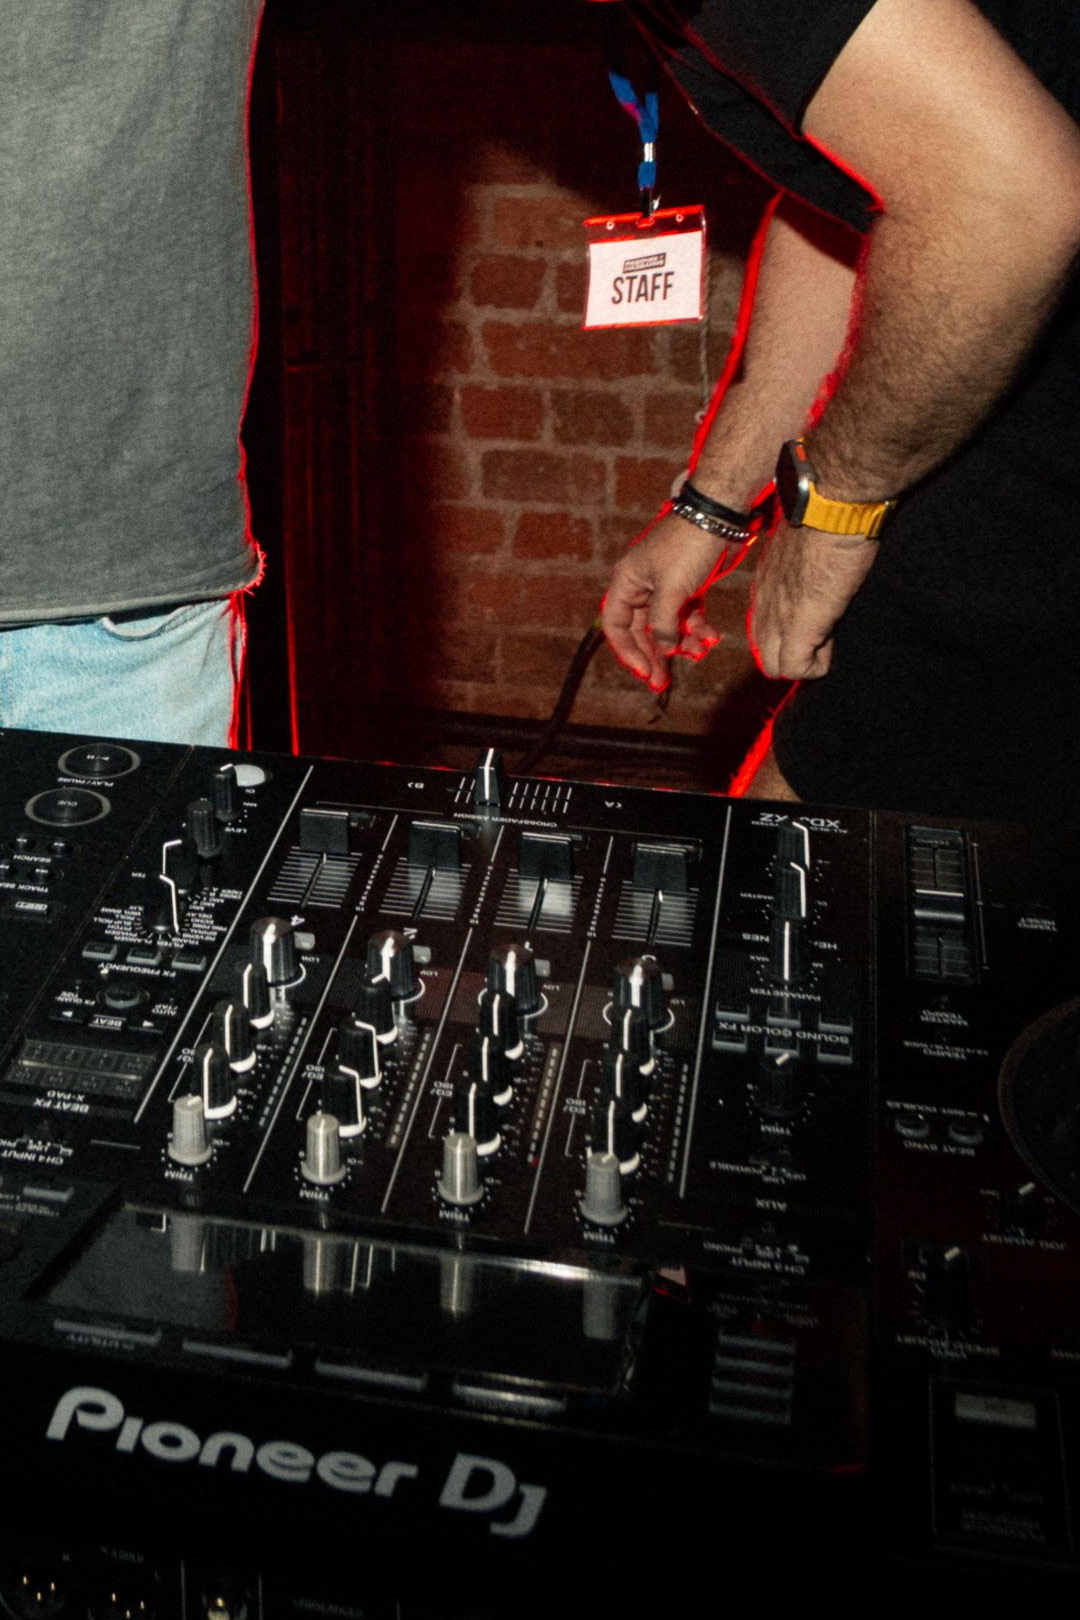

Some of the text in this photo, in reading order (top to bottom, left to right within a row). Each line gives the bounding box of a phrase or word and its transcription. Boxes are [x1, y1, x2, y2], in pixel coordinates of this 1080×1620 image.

[612, 272, 675, 304] STAFF
[57, 777, 114, 787] PLAY/PAUSE
[453, 812, 496, 822] ASSIGN
[13, 854, 52, 863] SEARCH
[18, 883, 49, 893] TRACK
[93, 916, 113, 924] ROLL
[185, 911, 212, 919] DELAY
[290, 915, 306, 925] 4
[104, 929, 138, 938] PHASER
[182, 933, 216, 941] REVERB
[189, 928, 218, 936] SPIRAL
[114, 935, 153, 944] FLANGER
[156, 940, 184, 948] FILTER
[171, 937, 199, 945] TRANS
[97, 962, 176, 978] FX FREQUENCY
[749, 987, 821, 1002] PARAMETER
[151, 1007, 177, 1017] AUTO
[91, 1017, 123, 1028] BEAT
[718, 1020, 850, 1045] SOUND COLOR FX
[46, 1090, 85, 1102] X-PAD
[33, 1097, 90, 1115] BEAT FX
[760, 1123, 792, 1136] TRIM
[0, 1148, 37, 1162] INPUT
[163, 1170, 194, 1182] TRIM
[299, 1189, 330, 1201] TRIM
[754, 1197, 788, 1212] AUX
[438, 1209, 470, 1221] TRIM
[583, 1230, 616, 1244] TRIM
[45, 1385, 419, 1497] Pioneer
